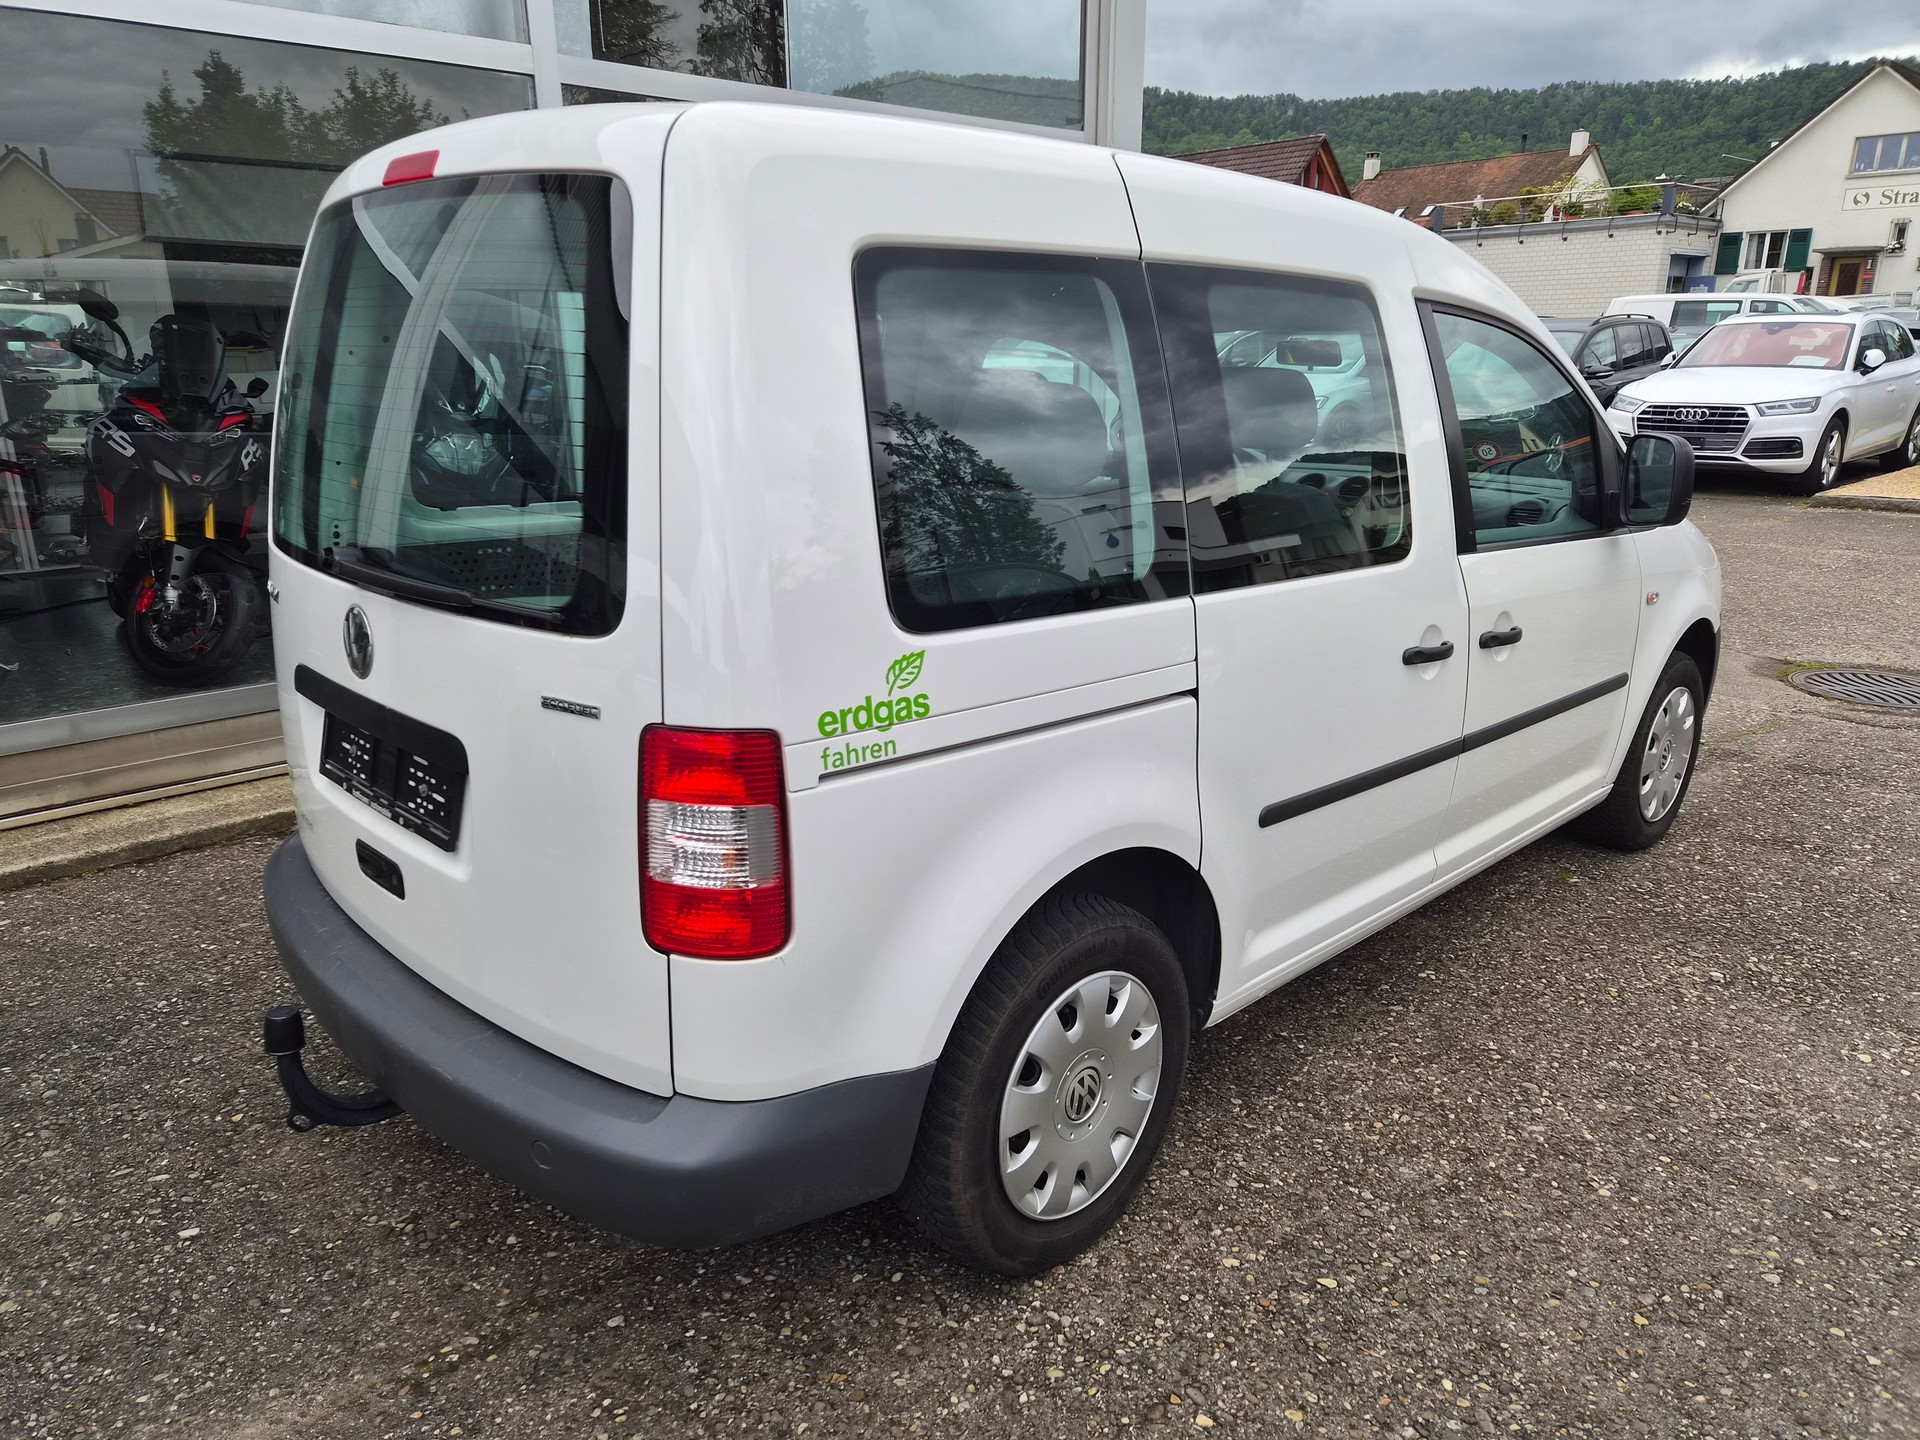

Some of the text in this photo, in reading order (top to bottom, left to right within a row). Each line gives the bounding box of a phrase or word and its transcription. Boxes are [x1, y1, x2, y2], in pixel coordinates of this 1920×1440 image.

[1879, 188, 1920, 206] Stra
[817, 693, 931, 737] erdgas
[820, 739, 897, 771] fahren
